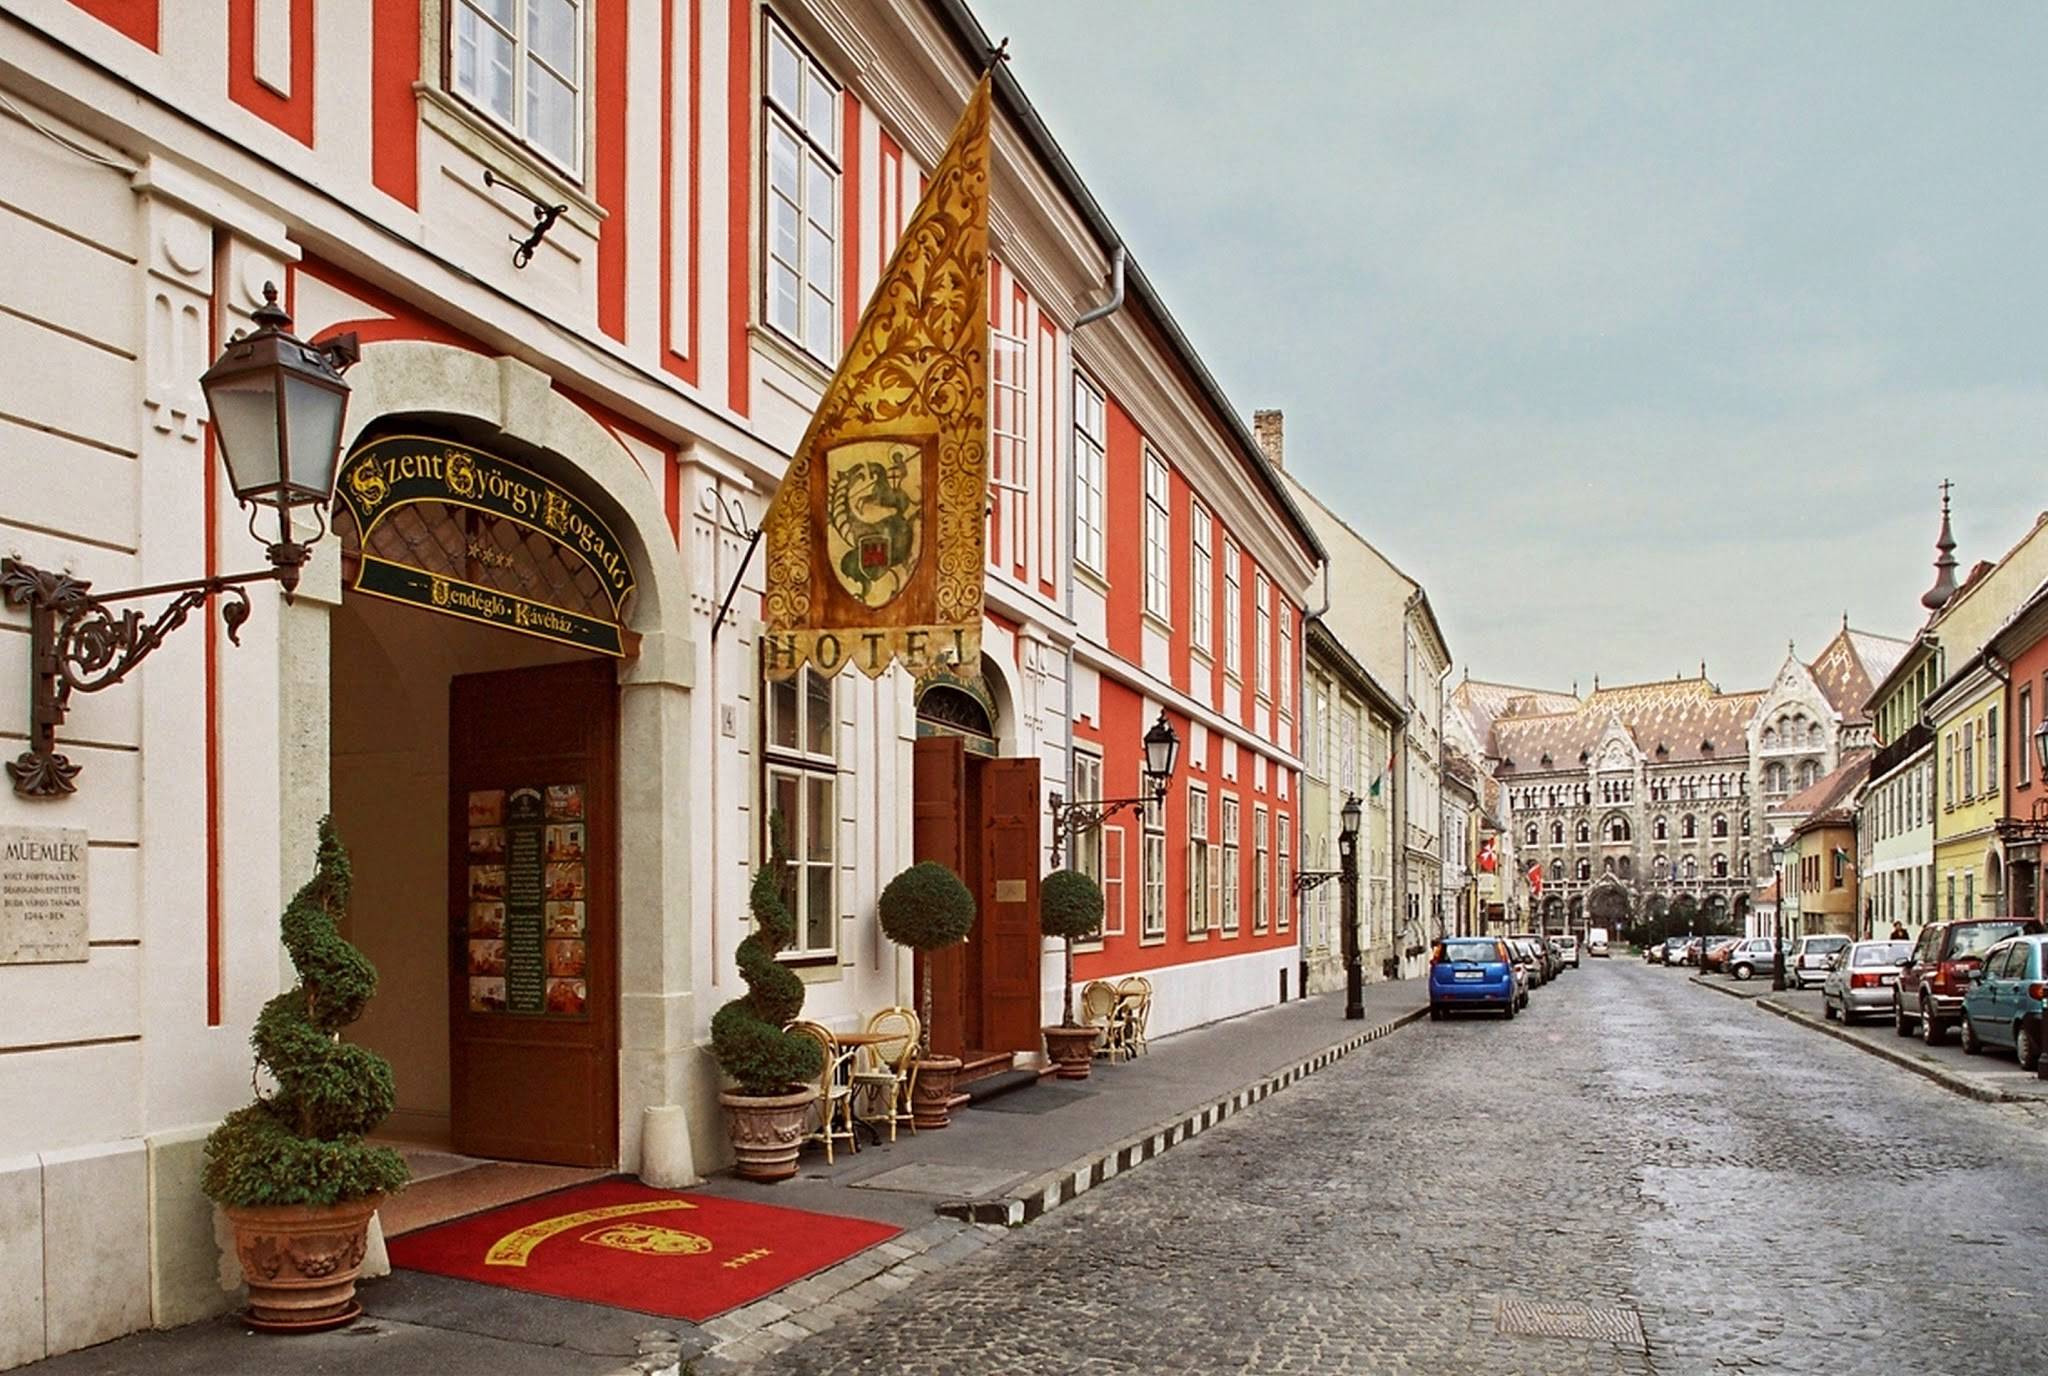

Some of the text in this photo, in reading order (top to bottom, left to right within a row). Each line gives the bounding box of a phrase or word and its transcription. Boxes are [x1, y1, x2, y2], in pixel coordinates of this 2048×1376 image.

[349, 453, 443, 516] Szent
[444, 449, 541, 518] György
[767, 628, 977, 671] HOTEL
